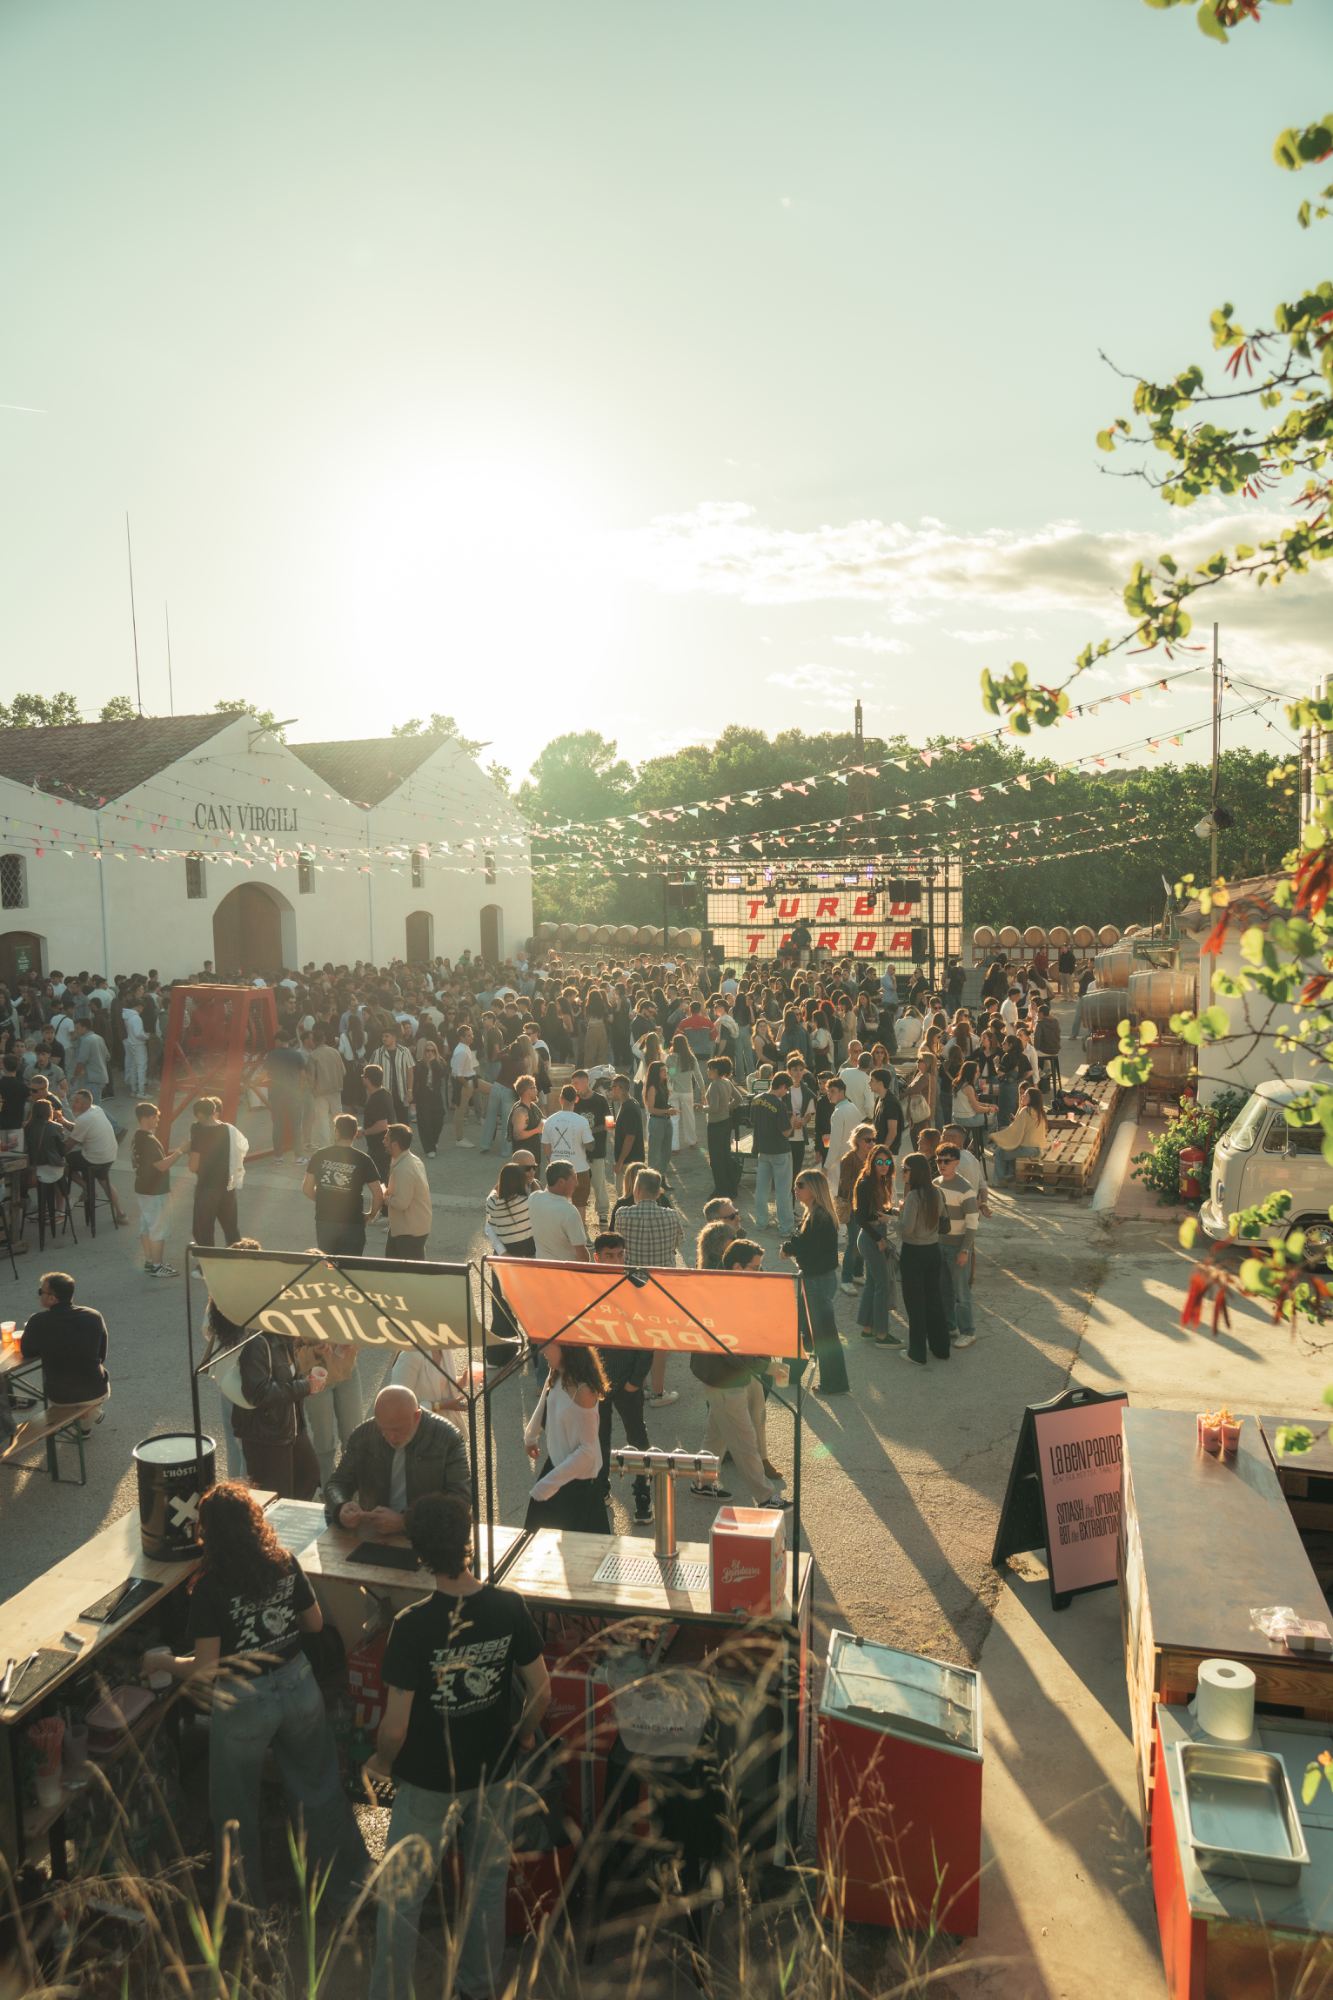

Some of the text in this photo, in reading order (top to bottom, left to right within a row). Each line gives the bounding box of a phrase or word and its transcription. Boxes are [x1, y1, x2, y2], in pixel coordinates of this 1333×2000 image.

[195, 802, 299, 832] CAN VIRGILI
[746, 896, 914, 919] TURBO
[163, 1465, 198, 1478] L'HÒSTI
[1057, 1499, 1085, 1525] SMASH
[721, 1565, 761, 1584] Bandarra
[731, 1559, 741, 1569] El
[229, 1585, 295, 1620] TADA
[230, 1573, 298, 1609] TBO
[433, 1633, 513, 1661] TURBO
